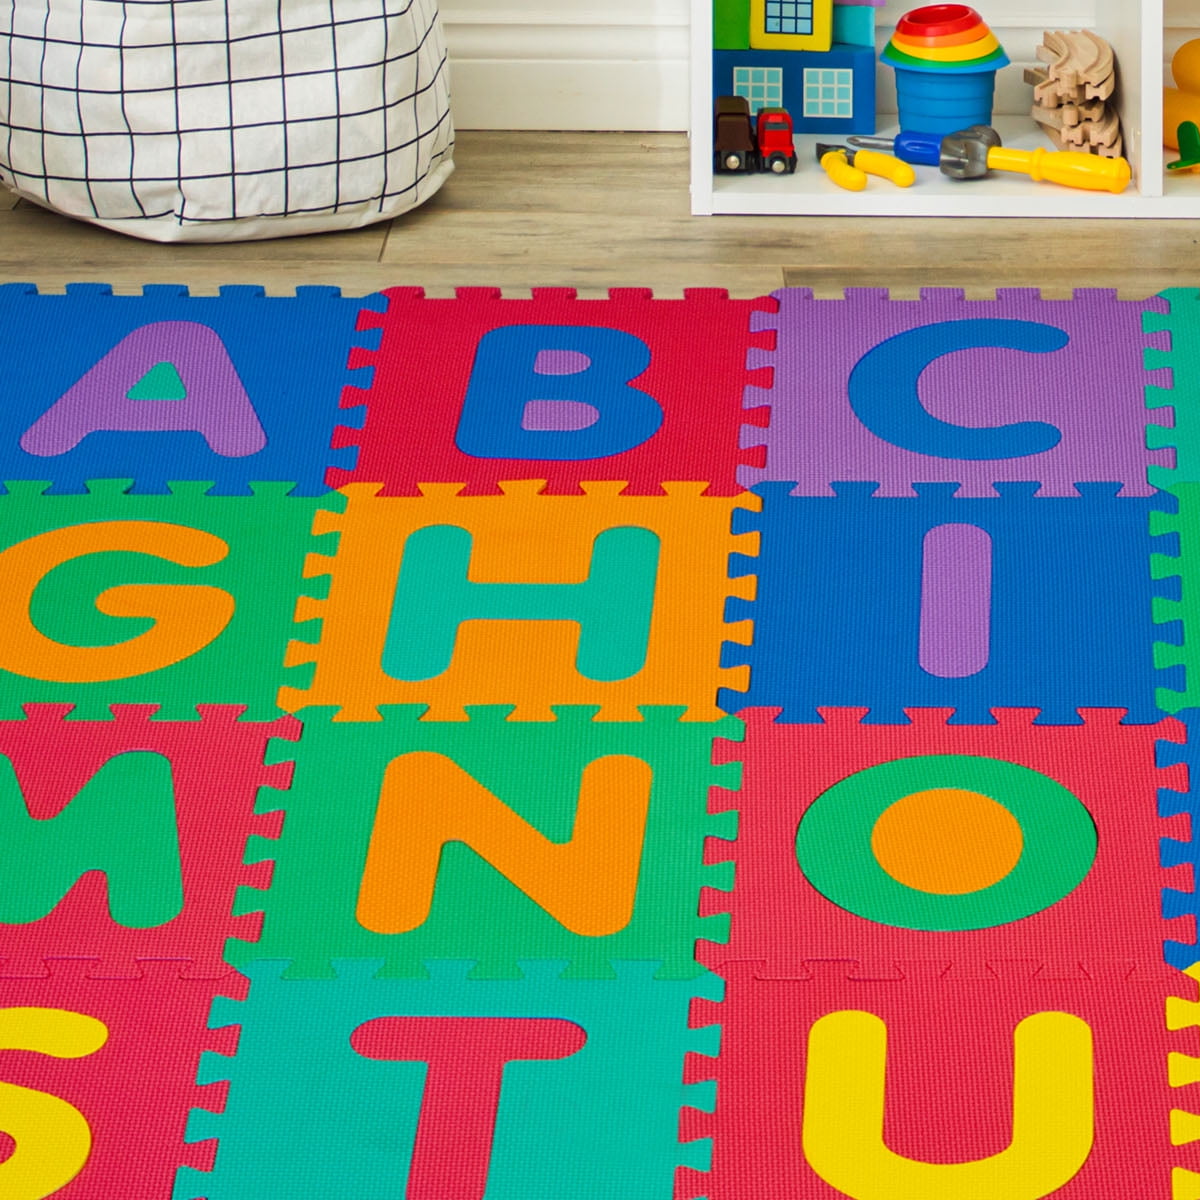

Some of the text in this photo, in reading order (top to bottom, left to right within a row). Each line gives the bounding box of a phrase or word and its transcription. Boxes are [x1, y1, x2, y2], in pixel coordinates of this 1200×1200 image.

[18, 320, 268, 458] A
[454, 324, 664, 461] B
[845, 316, 1071, 463] C
[0, 520, 235, 683] G
[380, 524, 661, 682] H
[918, 523, 992, 678] I
[355, 751, 653, 937] N
[795, 754, 1098, 931] O
[349, 1016, 588, 1200] T
[802, 1010, 1094, 1200] U
